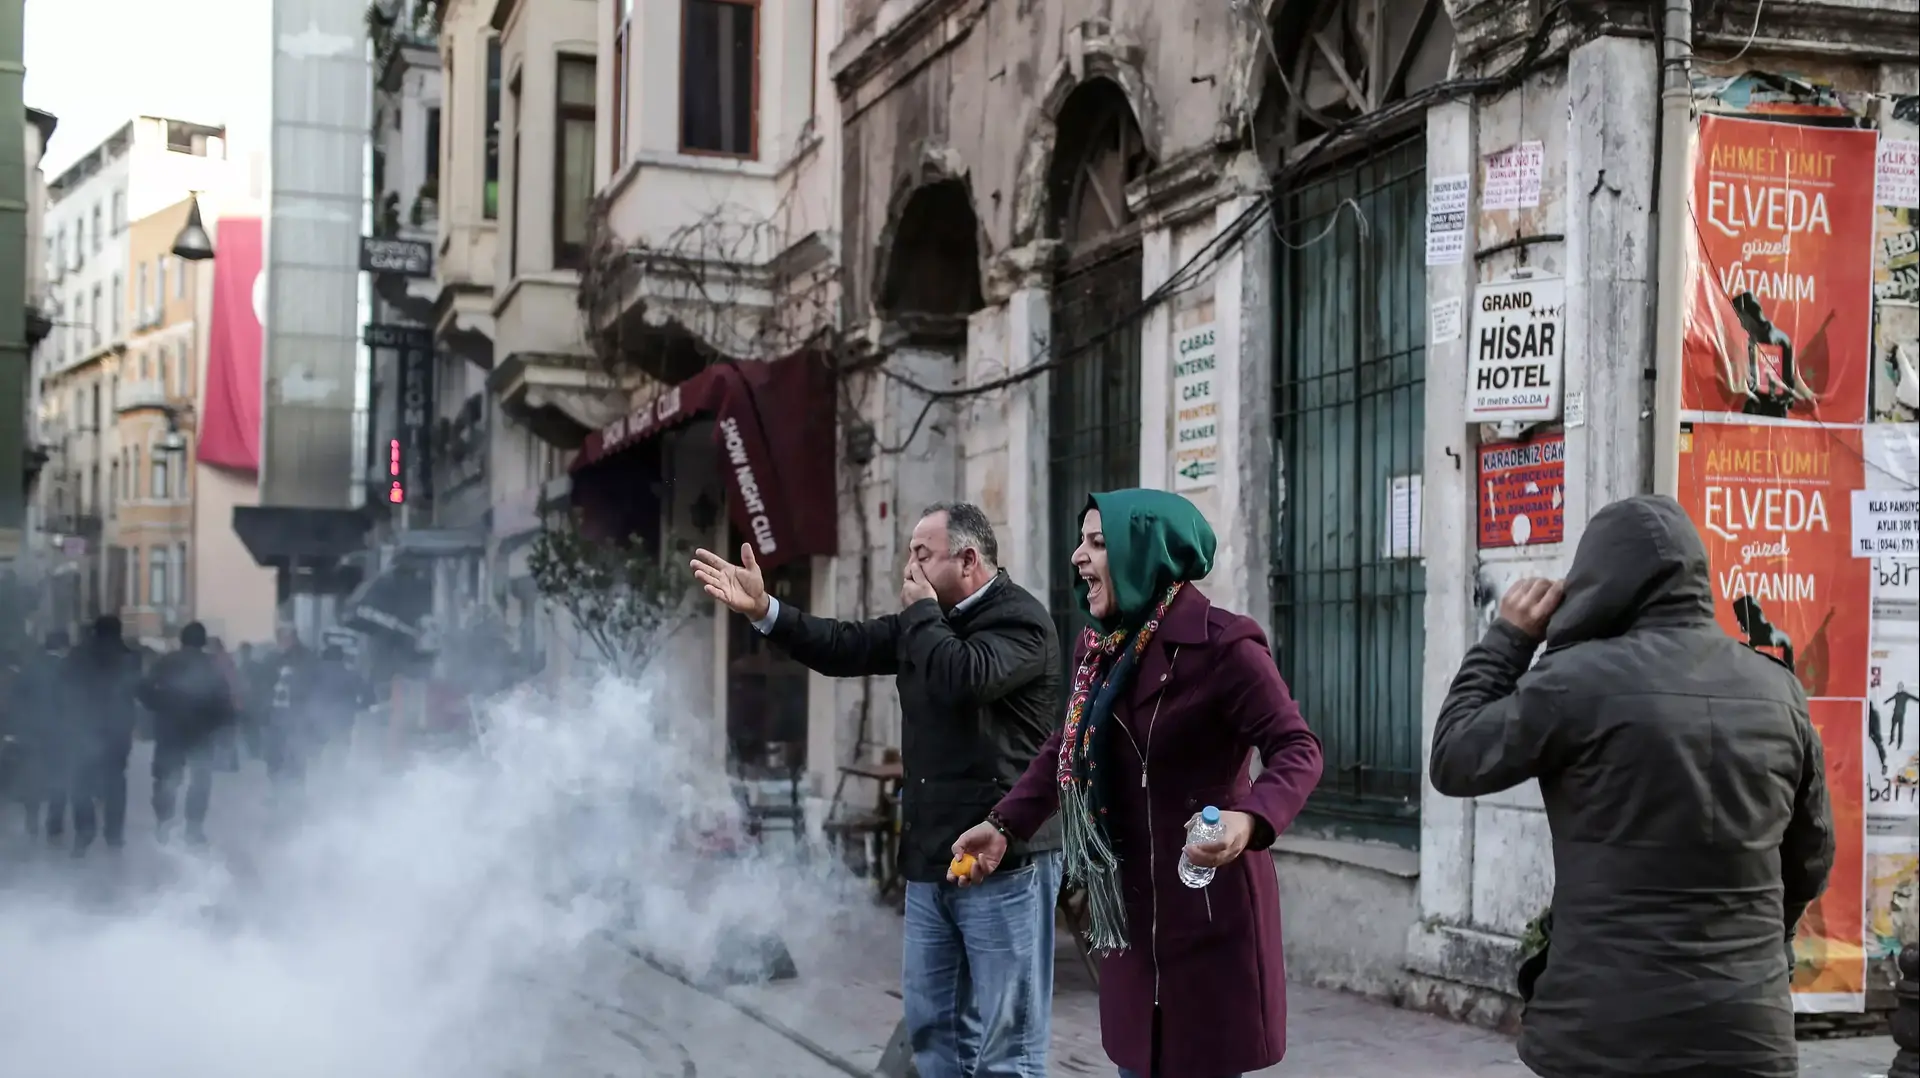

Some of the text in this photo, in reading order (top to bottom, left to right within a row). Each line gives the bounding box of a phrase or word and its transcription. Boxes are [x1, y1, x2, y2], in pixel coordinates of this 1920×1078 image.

[1710, 142, 1778, 172] AHMET
[1708, 180, 1831, 236] ELVEDA
[1742, 234, 1791, 261] güzel
[1720, 262, 1815, 303] VATANIM
[1482, 291, 1532, 312] GRAND
[1479, 316, 1555, 361] HİSAR
[1477, 364, 1551, 390] HOTEL
[1183, 381, 1210, 401] CAFE
[1488, 396, 1510, 405] metre
[1512, 394, 1543, 404] SOLDA
[1483, 445, 1541, 471] KARADENİZ
[1705, 448, 1831, 475] AHMET ÜMİT
[720, 417, 777, 555] SHOW NIGHT CLUB
[1704, 486, 1830, 541] ELVEDA
[1869, 500, 1888, 512] KLAS
[1877, 519, 1898, 531] AYLIK
[1900, 520, 1912, 531] 300
[1741, 532, 1790, 564] güzel
[1719, 565, 1815, 602] VATANIM
